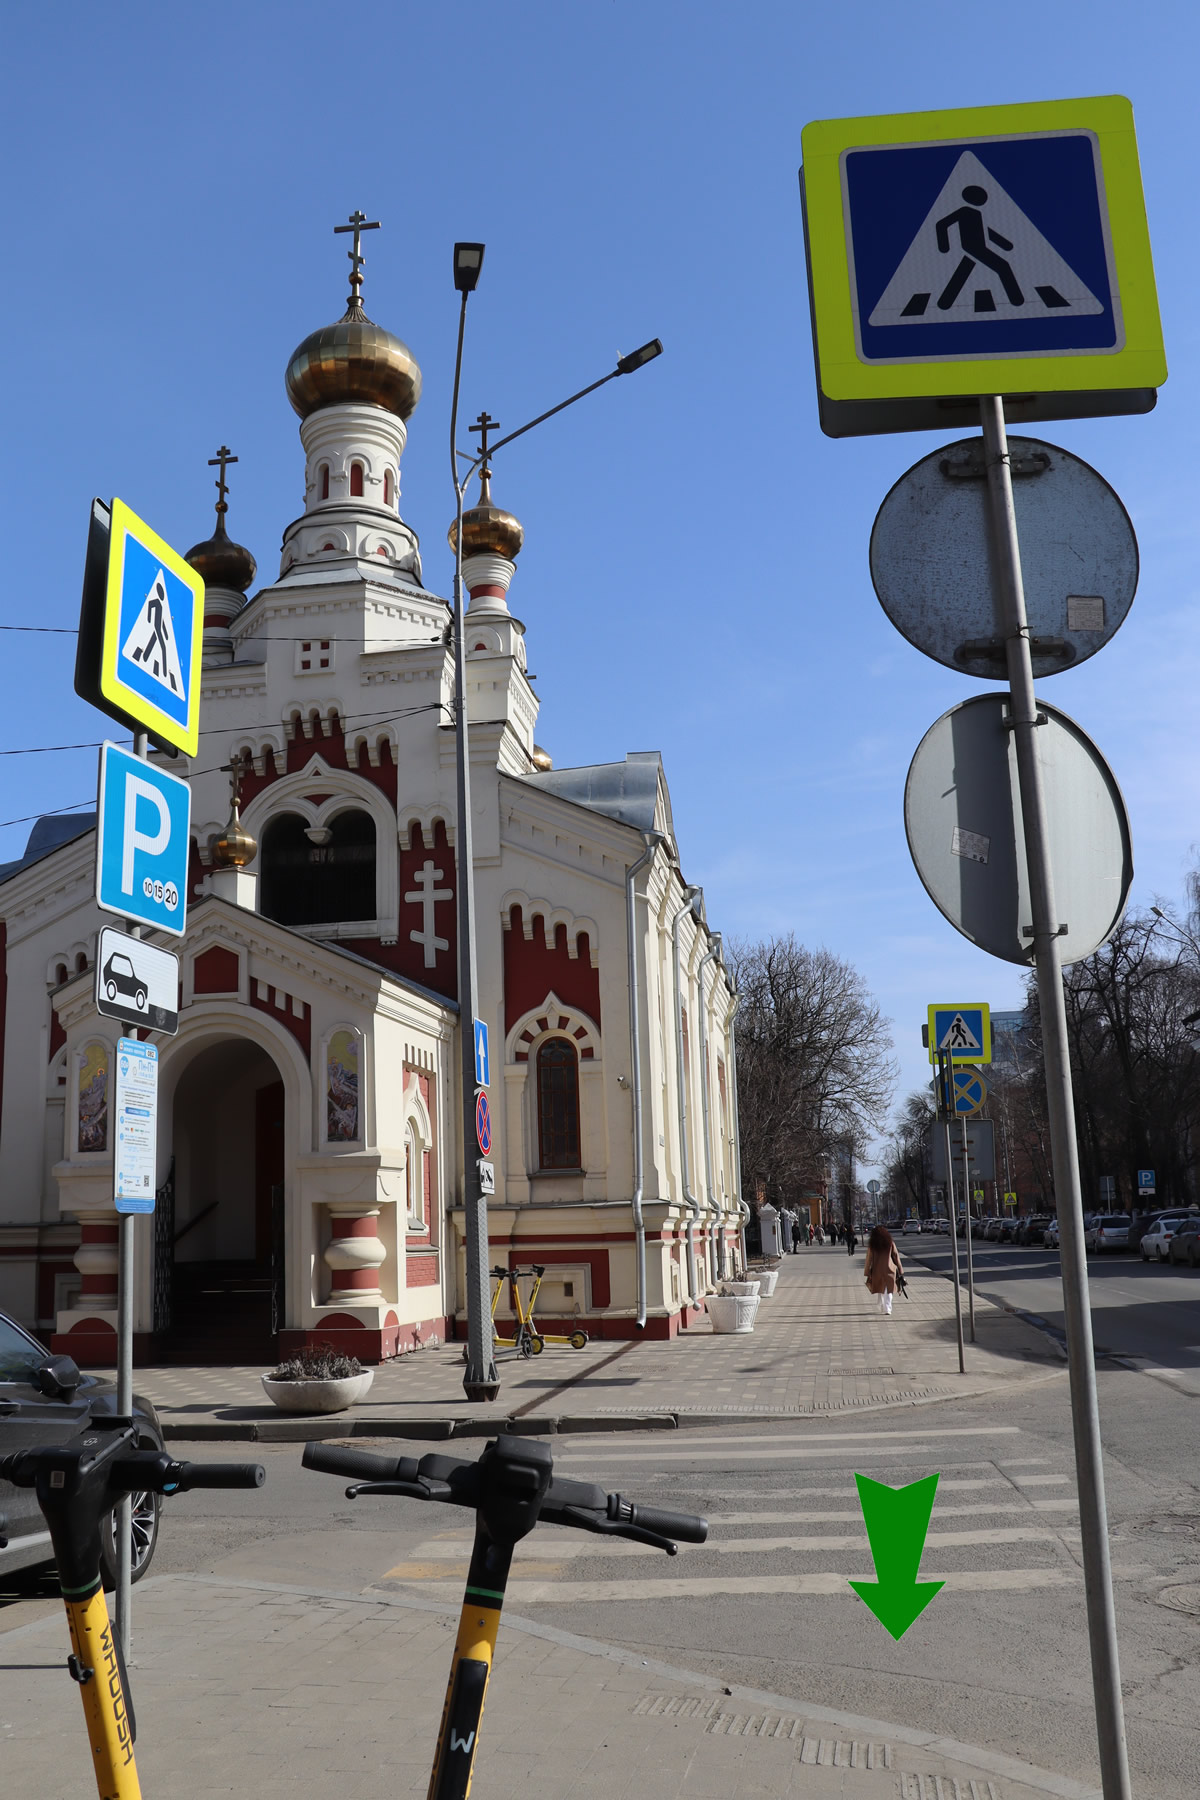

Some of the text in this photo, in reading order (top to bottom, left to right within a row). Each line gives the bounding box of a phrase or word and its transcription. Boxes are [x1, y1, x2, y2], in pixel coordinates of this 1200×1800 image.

[121, 771, 171, 896] P
[144, 881, 178, 906] 10 15 20
[1142, 1172, 1151, 1185] P
[100, 1624, 133, 1766] WHOOSH
